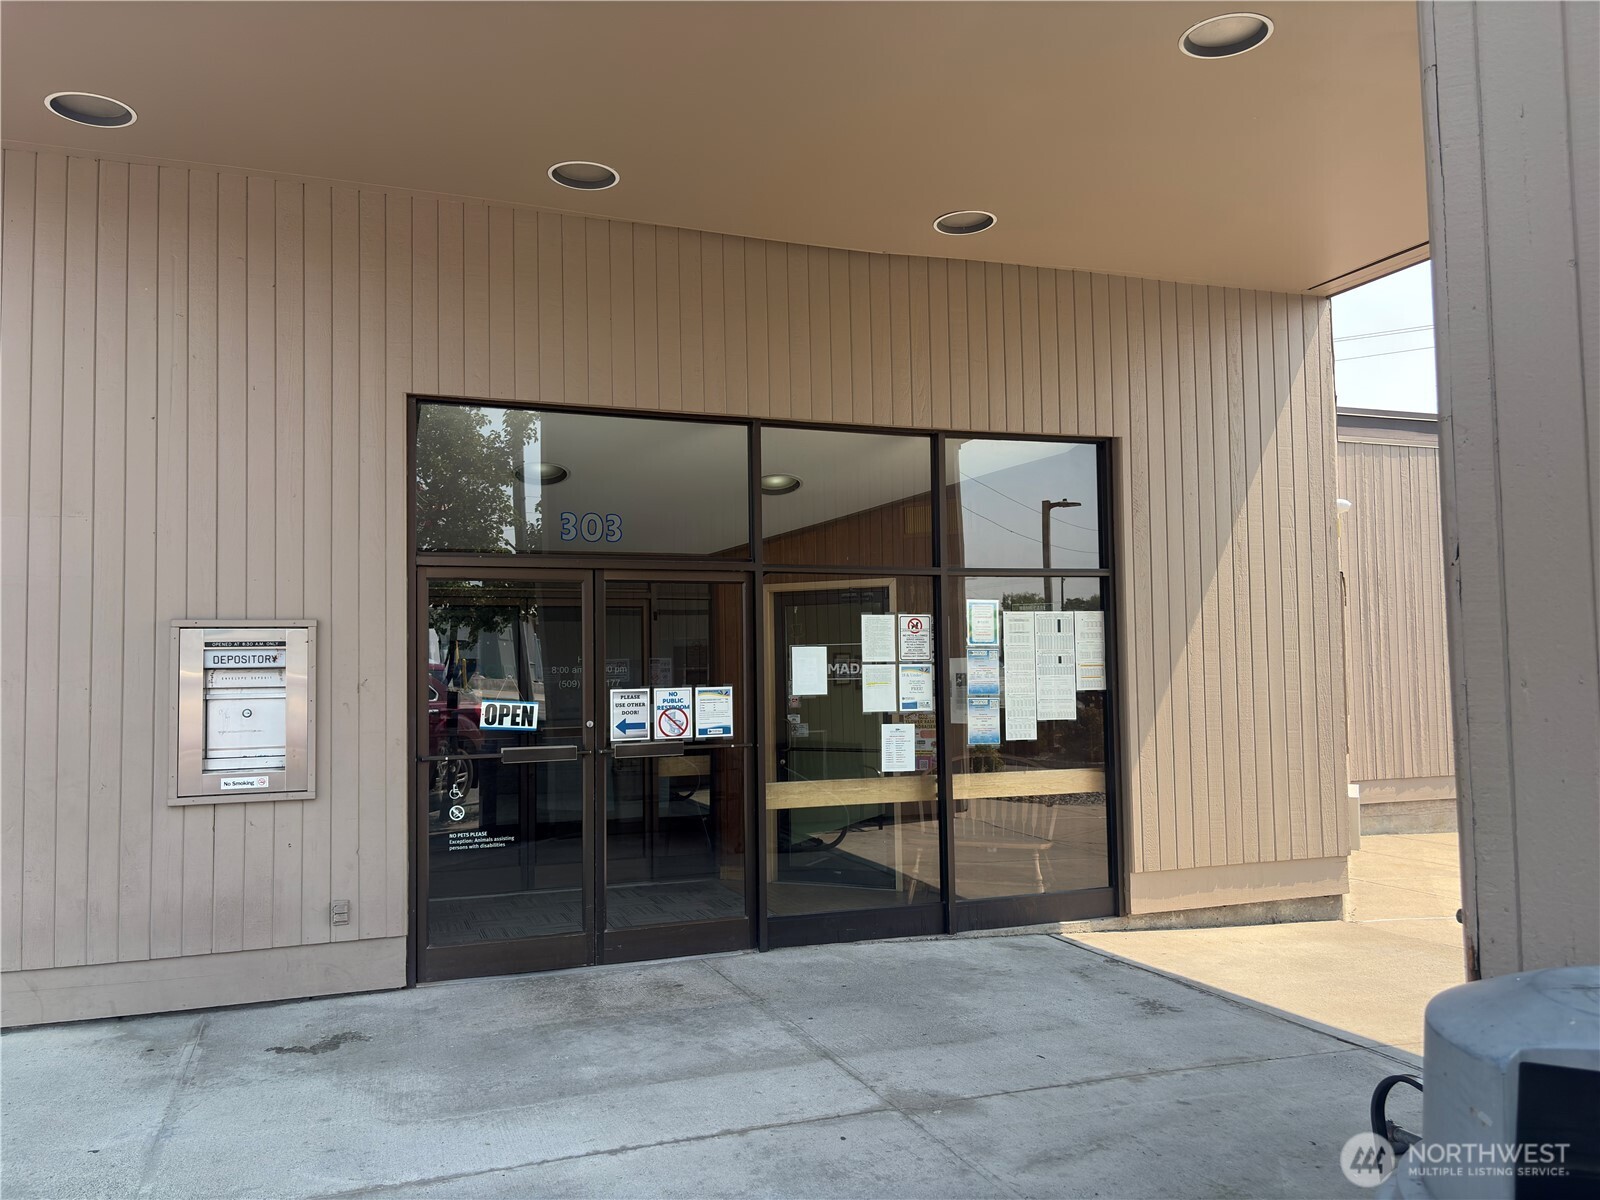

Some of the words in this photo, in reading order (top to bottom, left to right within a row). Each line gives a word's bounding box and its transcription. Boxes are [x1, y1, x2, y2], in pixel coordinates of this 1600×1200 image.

[560, 511, 623, 543] 303
[212, 655, 278, 665] DEPOSITORY
[551, 666, 569, 674] 8:00
[827, 663, 863, 675] MAD
[558, 680, 581, 689] (509)
[484, 703, 535, 727] OPEN
